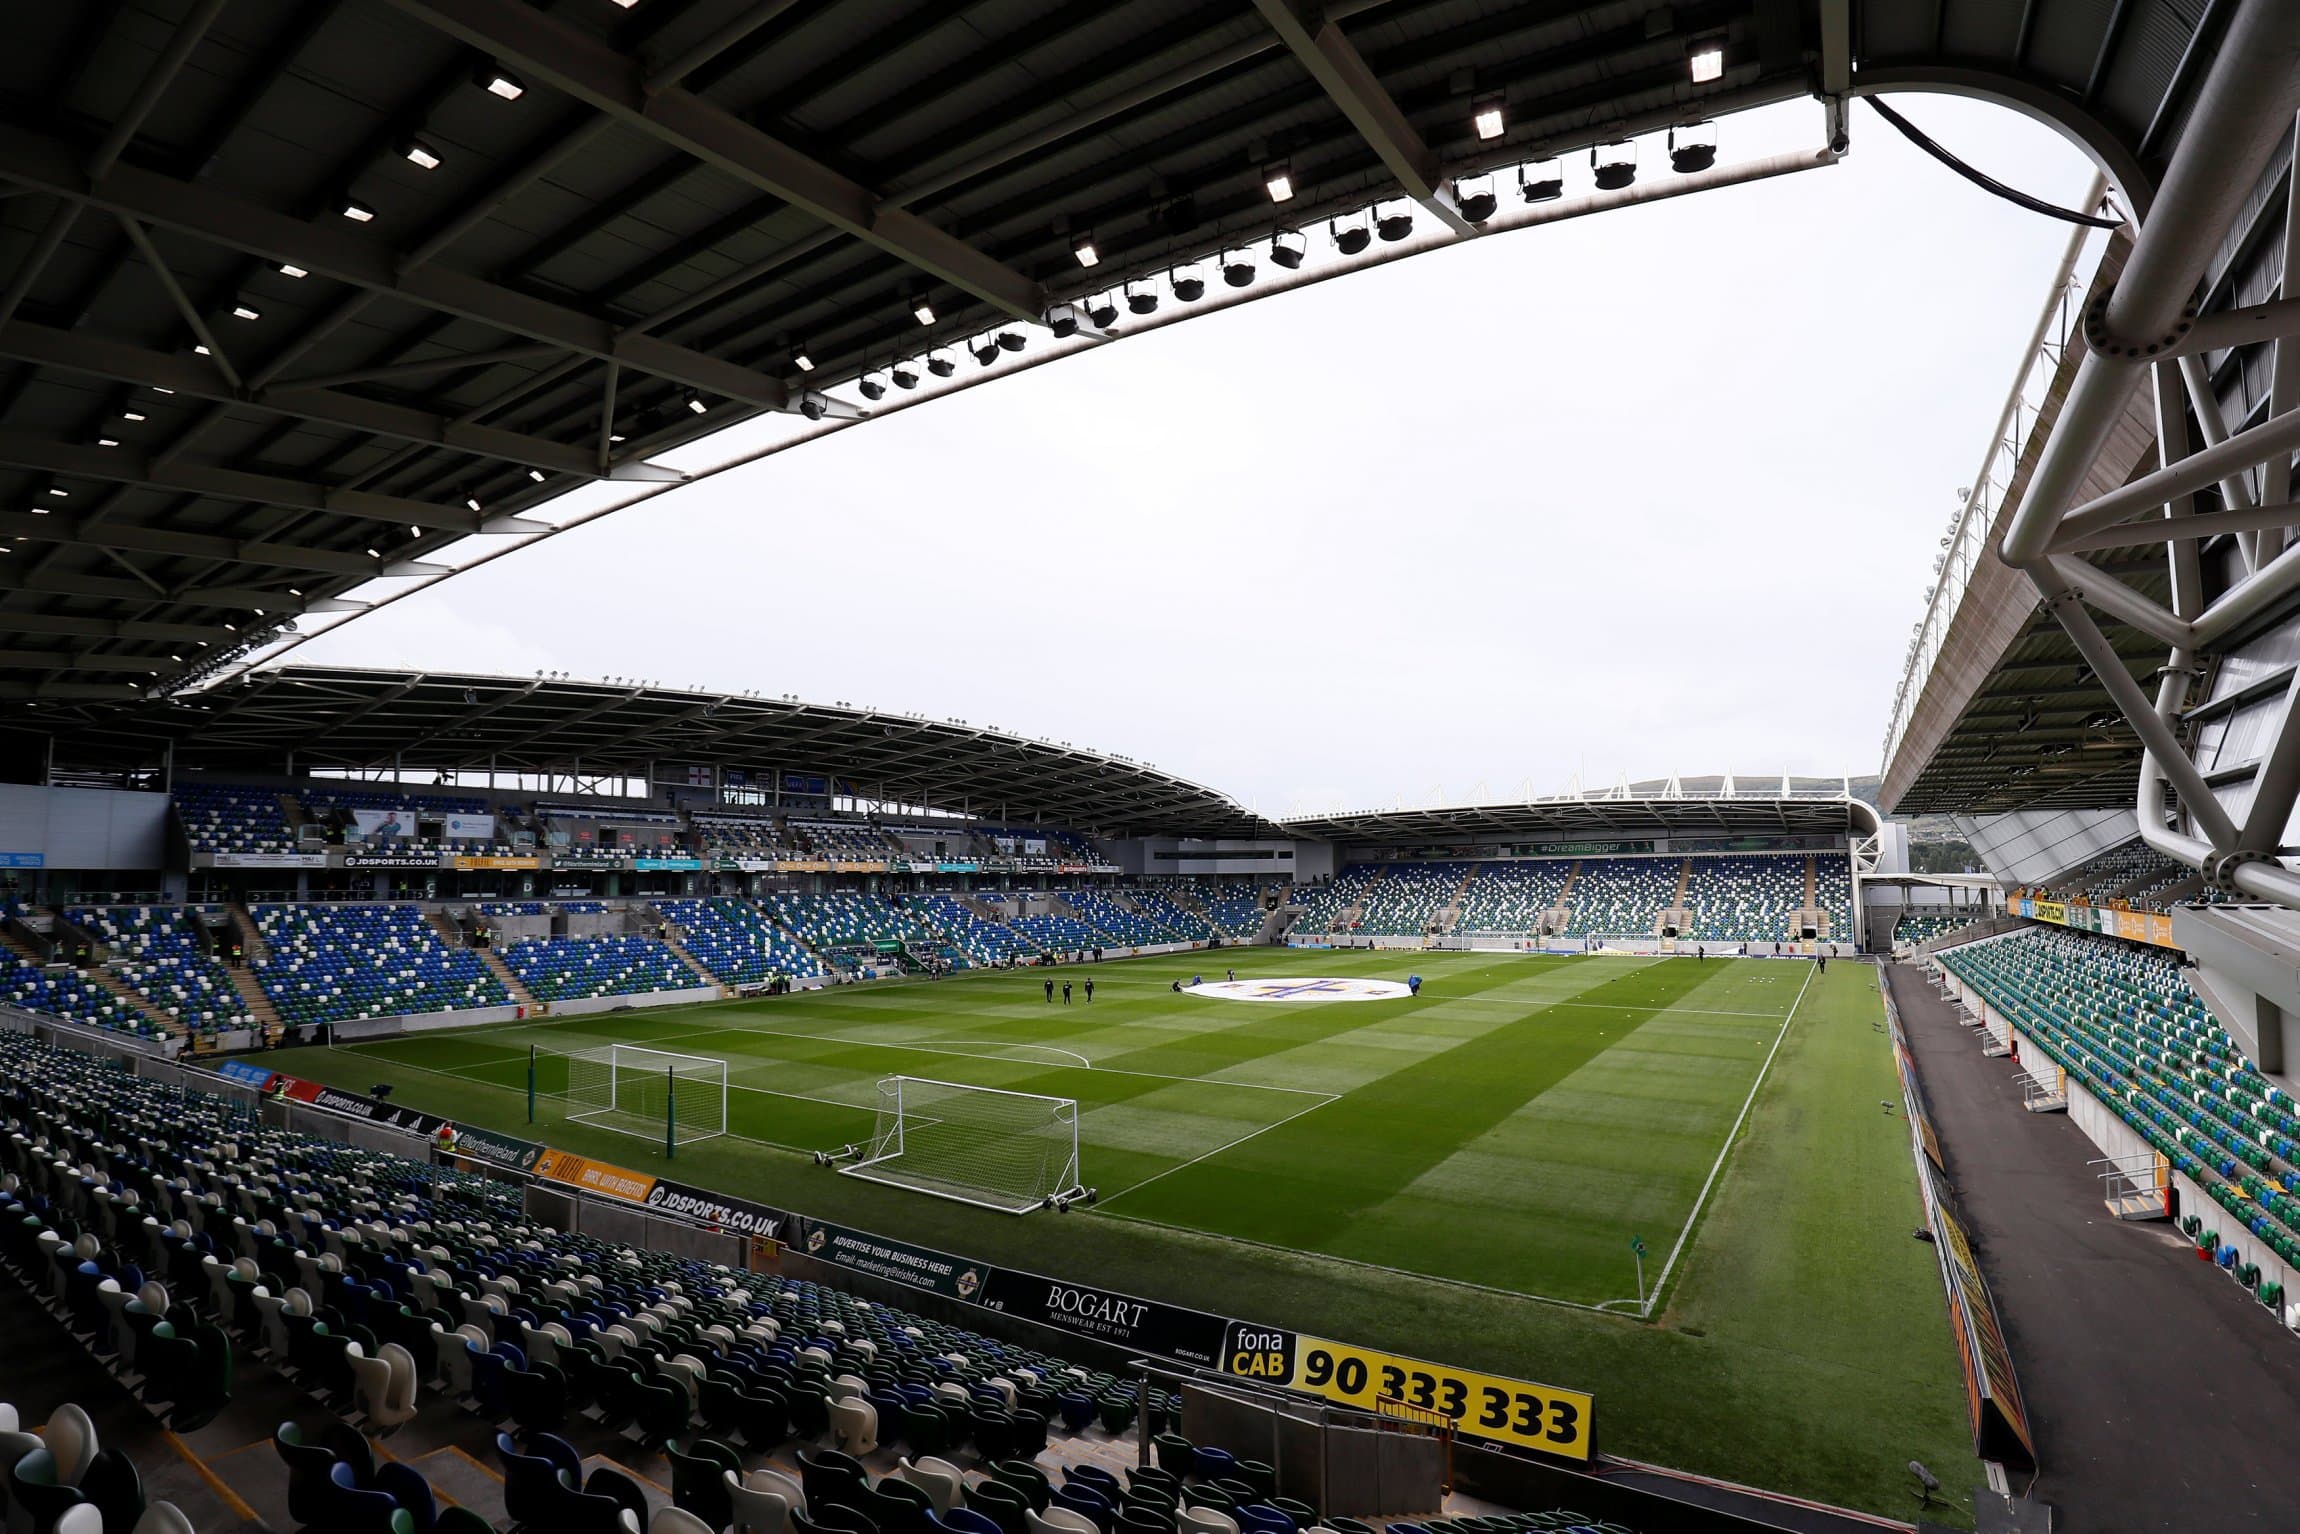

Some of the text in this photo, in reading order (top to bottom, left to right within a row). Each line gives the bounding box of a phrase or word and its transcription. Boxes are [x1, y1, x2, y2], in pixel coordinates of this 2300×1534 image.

[1542, 843, 1621, 853] #DreamBigger
[356, 857, 438, 866] JDSPORTS.CO.UK
[523, 882, 533, 892] D
[459, 1134, 520, 1162] @NorthernIreland
[600, 1173, 619, 1190] WITH
[615, 1178, 647, 1198] BENEFITS
[833, 1236, 952, 1276] ADVERTISE YOUR BUSINESS HERE!
[834, 1251, 936, 1288] Email: marketing@irishfa.com
[1045, 1285, 1149, 1328] BOGART
[1050, 1311, 1130, 1338] MENSWEAR EST 1971
[1237, 1327, 1283, 1352] fona
[1175, 1347, 1210, 1362] BOGART.CO.UK
[1232, 1352, 1285, 1377] CAB
[1305, 1349, 1579, 1445] 90 333 333
